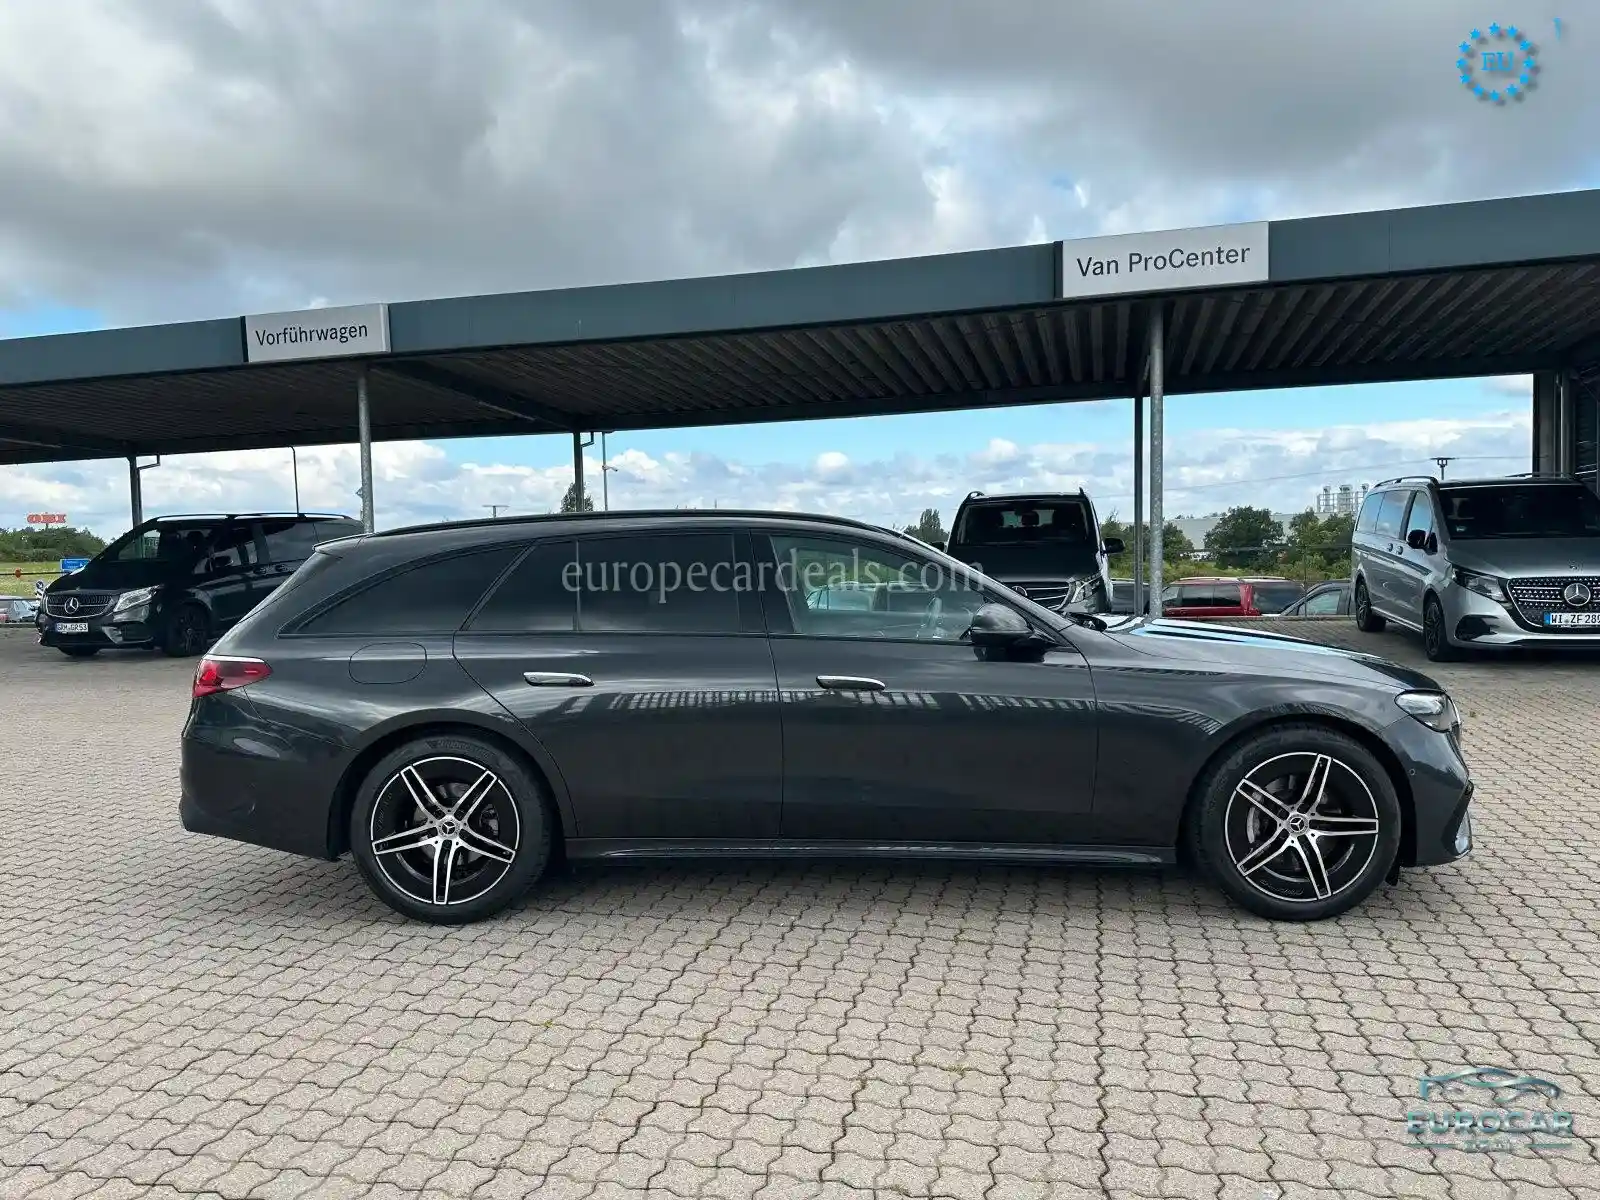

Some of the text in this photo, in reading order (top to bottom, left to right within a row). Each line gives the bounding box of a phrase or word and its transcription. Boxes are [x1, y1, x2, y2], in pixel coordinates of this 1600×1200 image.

[1076, 245, 1251, 277] Van ProCenter
[255, 323, 368, 346] Vorführwagen
